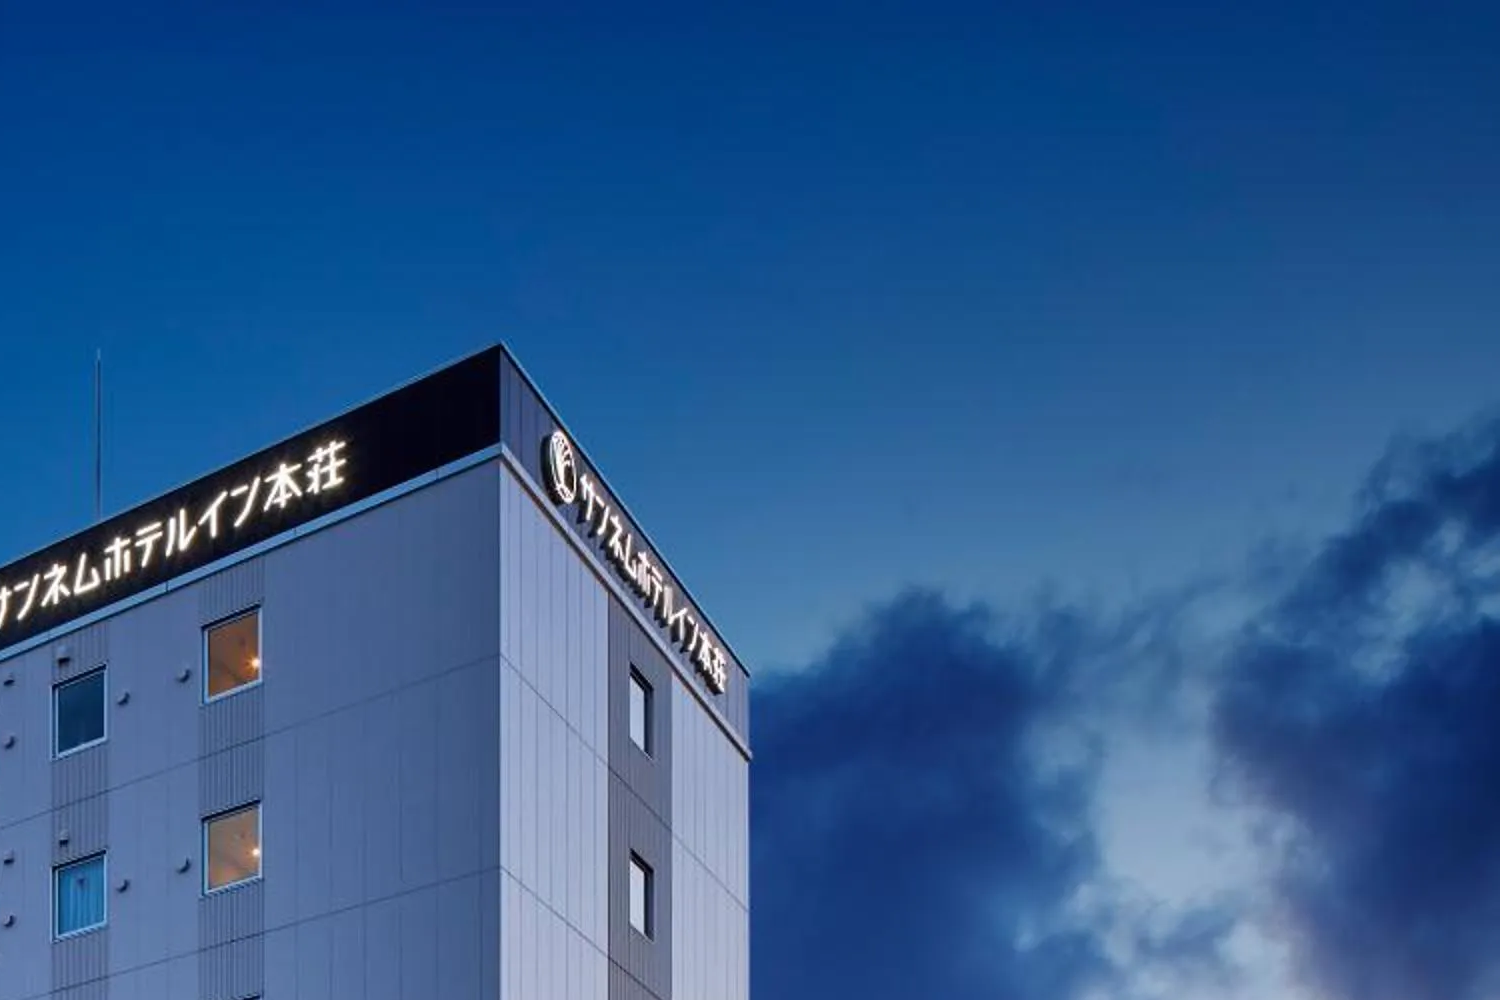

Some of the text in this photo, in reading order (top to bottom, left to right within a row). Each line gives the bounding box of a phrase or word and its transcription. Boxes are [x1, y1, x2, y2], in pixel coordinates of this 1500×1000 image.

[579, 473, 727, 693] サンネムホテルイン本荘
